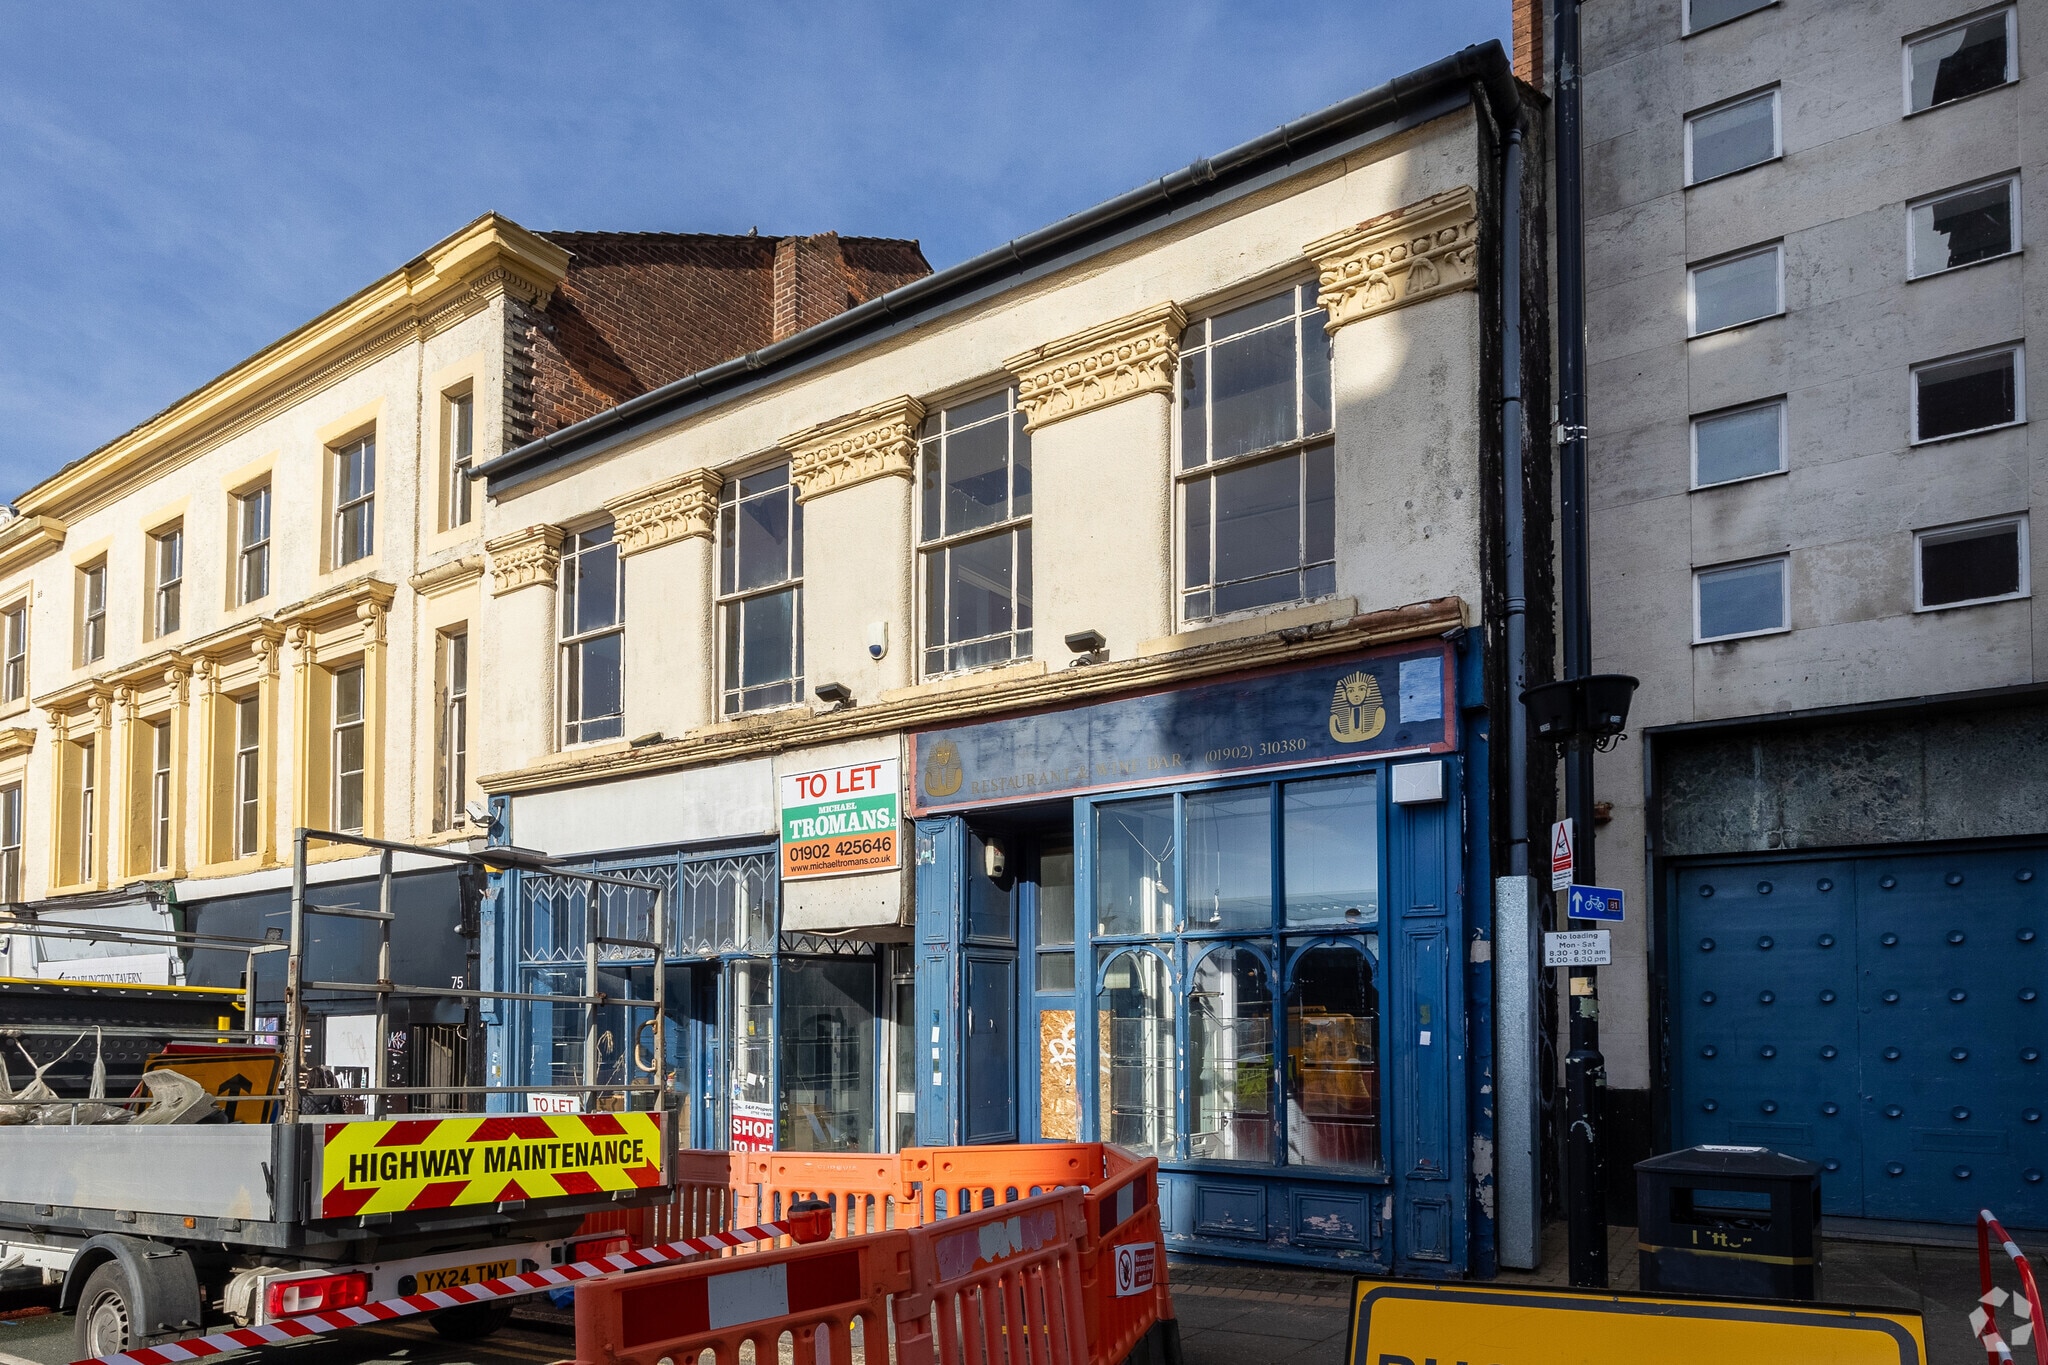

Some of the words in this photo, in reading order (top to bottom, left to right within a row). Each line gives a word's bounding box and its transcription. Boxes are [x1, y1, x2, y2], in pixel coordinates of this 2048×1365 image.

[971, 768, 1069, 795] RESTAURANT
[1095, 758, 1140, 776] WINE
[1149, 753, 1182, 770] BAR
[1204, 745, 1253, 764] (01902)
[1259, 738, 1306, 755] 310380
[795, 773, 828, 799] TO
[836, 765, 881, 794] LET
[818, 802, 857, 815] MICHAEL
[789, 807, 890, 839] TROMANS
[790, 843, 830, 862] 01902
[835, 836, 892, 856] 425646
[790, 855, 891, 872] www.michaeltromans.co.uk
[115, 972, 142, 983] TAVERN
[451, 976, 464, 989] 75
[533, 1097, 548, 1112] TO
[552, 1100, 574, 1112] LET
[732, 1118, 774, 1139] SHOP
[733, 1140, 748, 1152] TO
[752, 1142, 774, 1152] LET
[349, 1148, 476, 1183] HIGHWAY
[484, 1139, 644, 1173] MAINTENANCE
[424, 1268, 470, 1291] YX24
[476, 1262, 509, 1282] TMY
